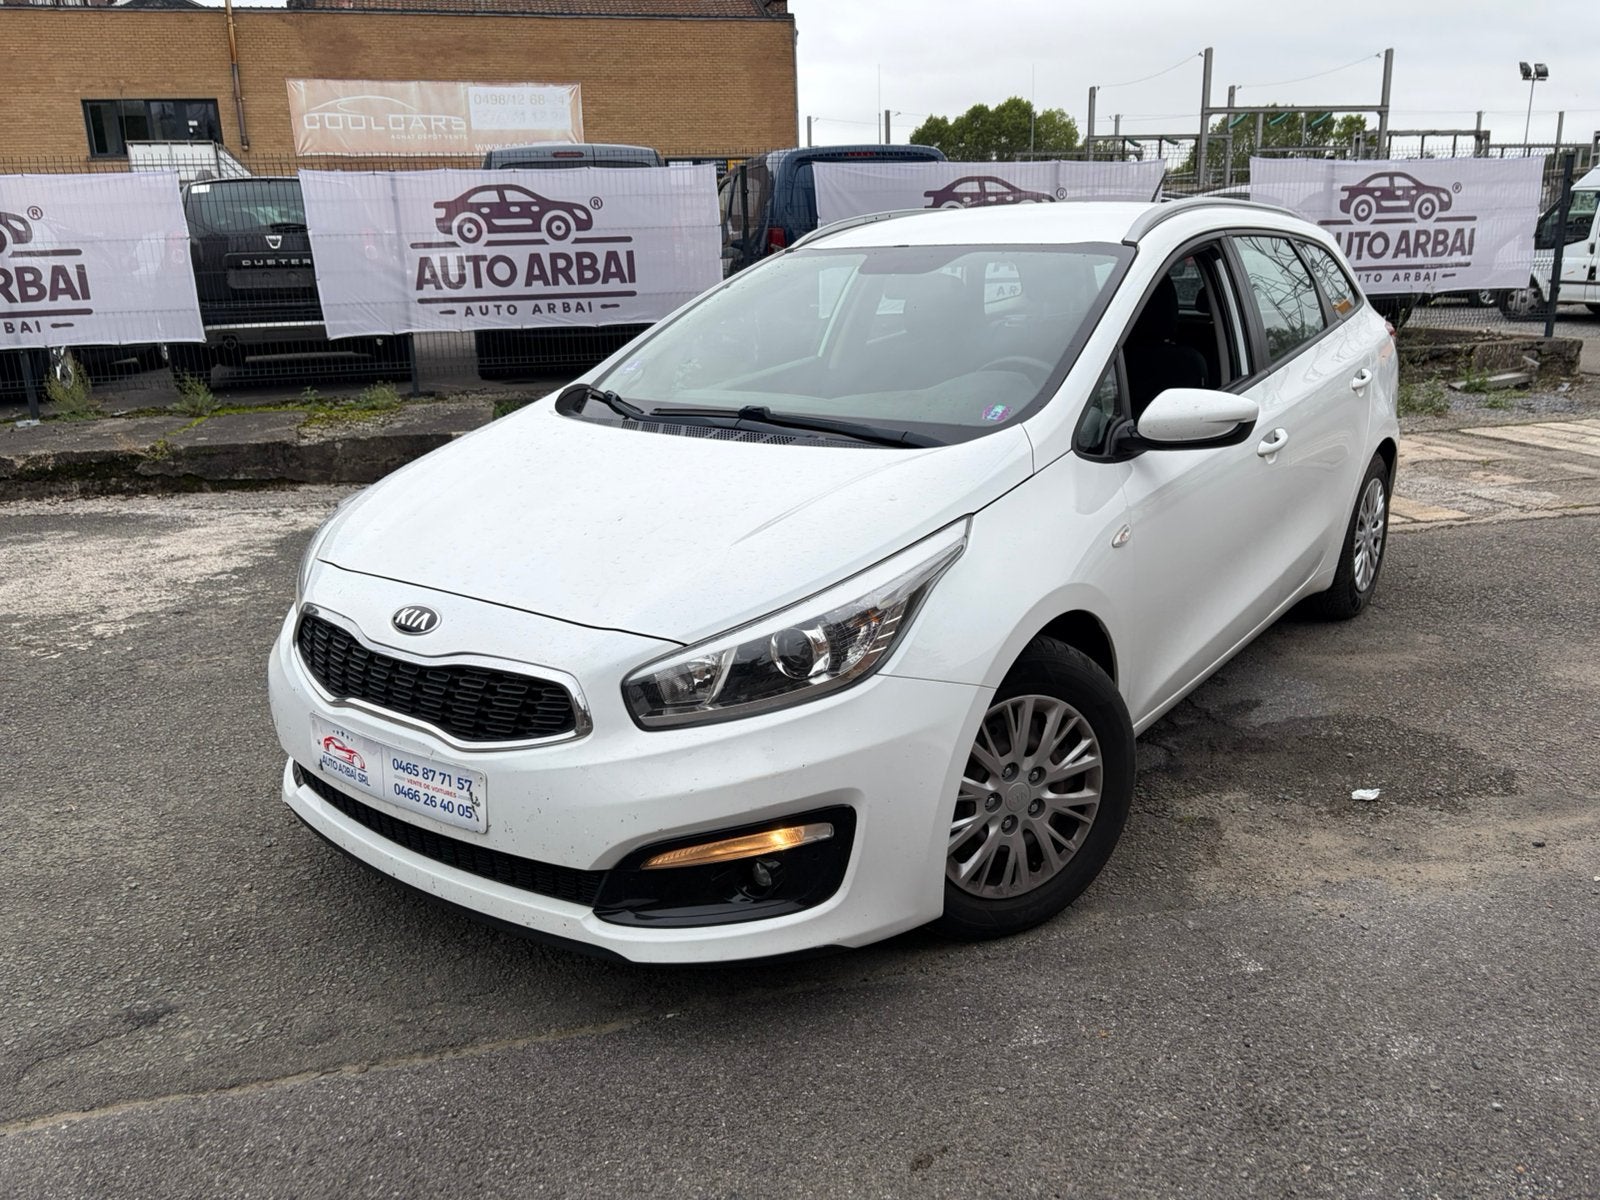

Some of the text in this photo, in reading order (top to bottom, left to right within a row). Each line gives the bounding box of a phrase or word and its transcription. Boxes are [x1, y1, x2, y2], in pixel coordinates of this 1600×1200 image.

[529, 93, 546, 106] 68
[1335, 228, 1476, 261] UTO ARBAI
[415, 250, 637, 291] AUTO ARBAI
[1392, 271, 1437, 283] ARBAI
[0, 264, 91, 304] RBAI
[464, 301, 593, 318] AUTO ARBAI
[3, 320, 42, 334] BAI
[396, 608, 430, 630] KIA
[322, 755, 338, 770] AUTO
[392, 758, 473, 793] 0465 87 71 57
[406, 778, 457, 799] VENTE DE VOITURES
[394, 783, 473, 819] 0466 26 40 05
